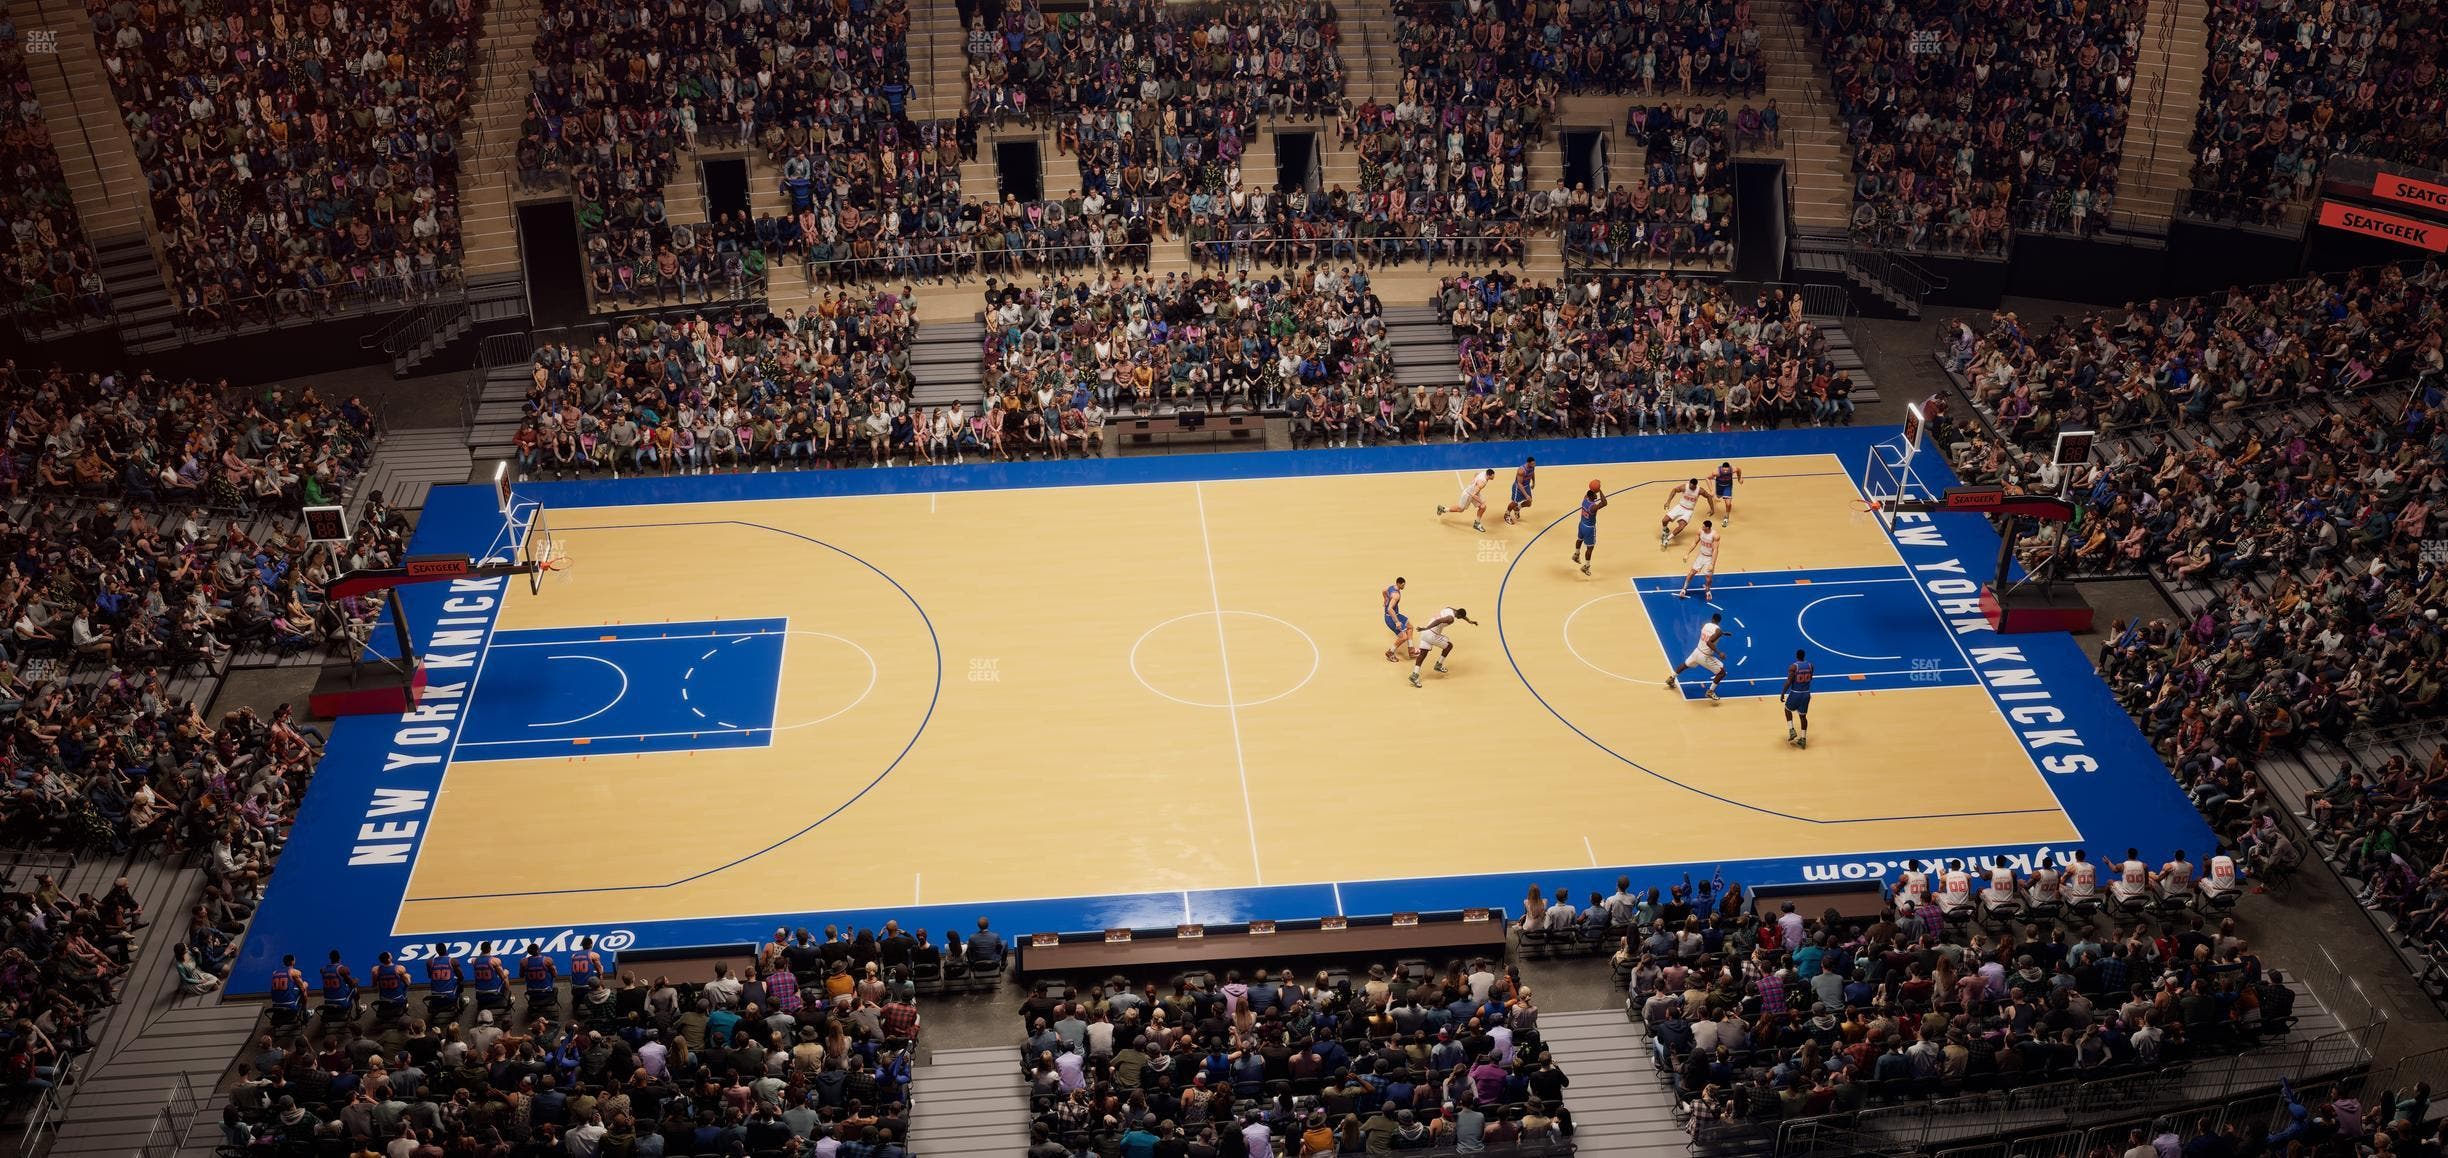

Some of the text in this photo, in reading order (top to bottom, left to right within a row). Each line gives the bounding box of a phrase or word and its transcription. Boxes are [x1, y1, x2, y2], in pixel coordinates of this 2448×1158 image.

[2342, 213, 2429, 244] SEATGEEK
[1953, 494, 1996, 504] SEATGEEK
[413, 563, 460, 573] SEATGEEK
[1914, 558, 1994, 635] YORK
[1969, 646, 2099, 774] KNICKS
[383, 681, 467, 772] YORK
[348, 788, 430, 866] NEW
[2215, 866, 2233, 878] 00
[2126, 873, 2144, 884] 00
[1949, 880, 1967, 892] 00
[1994, 881, 2012, 891] 00
